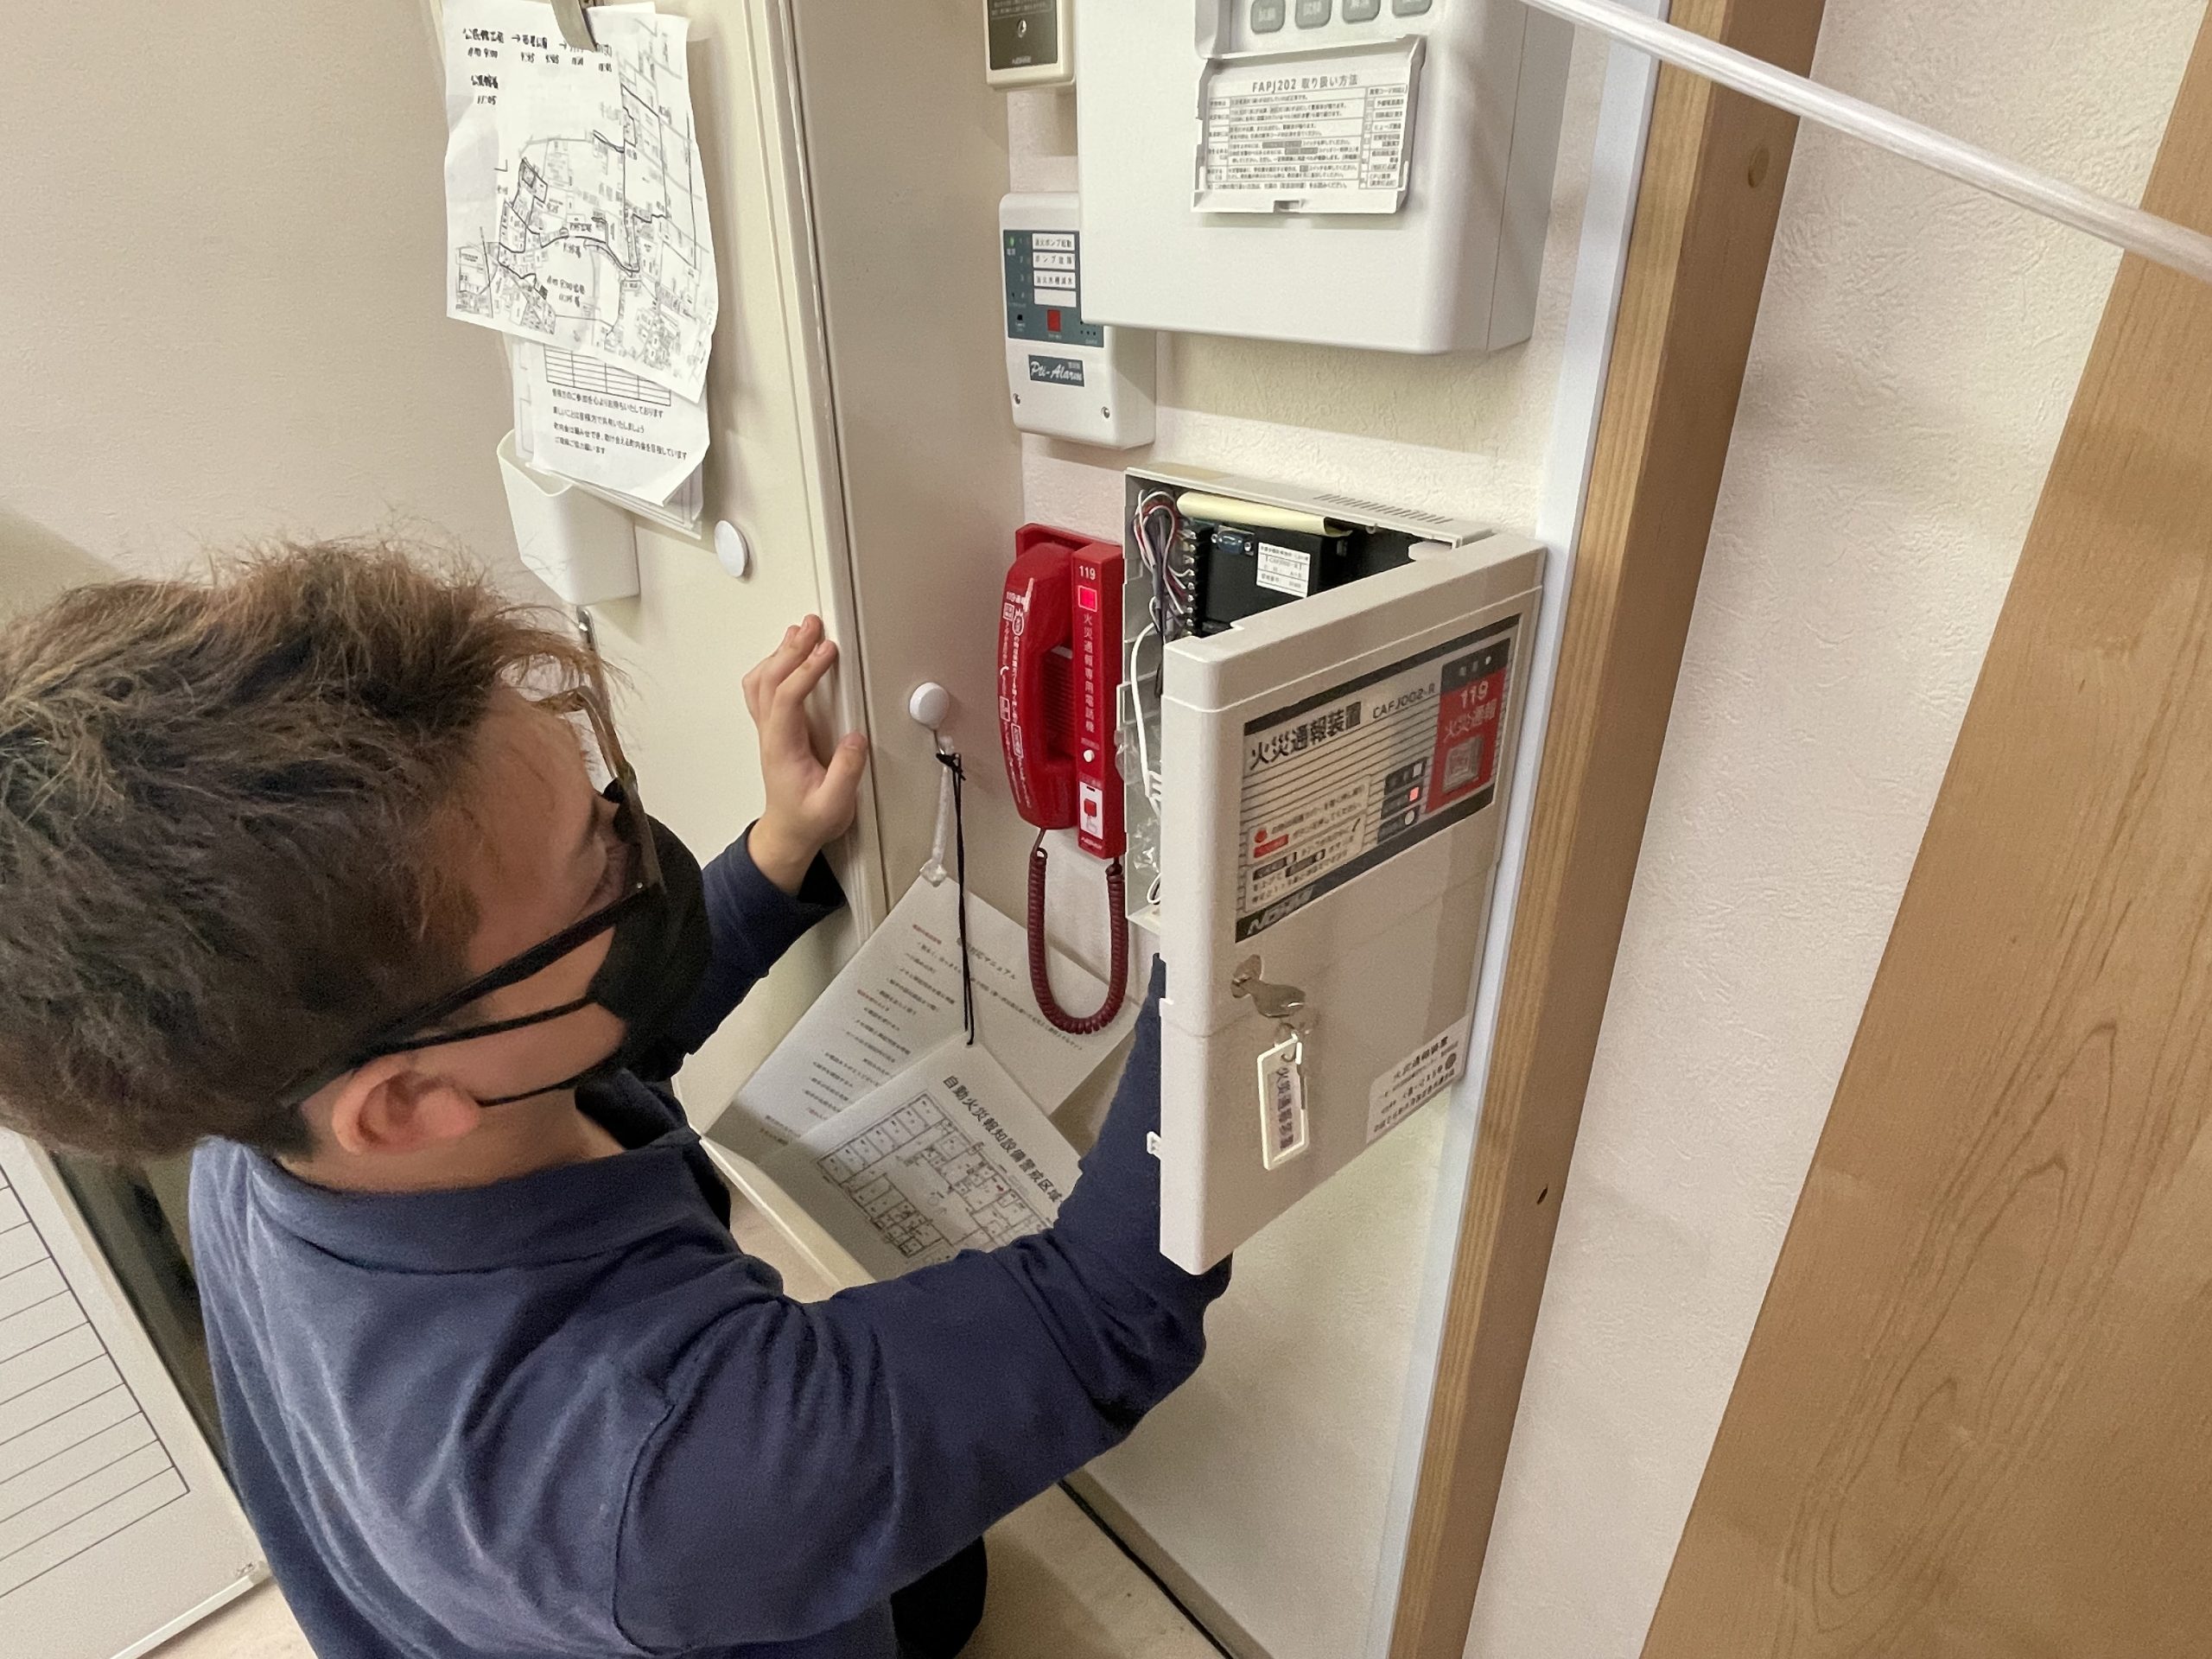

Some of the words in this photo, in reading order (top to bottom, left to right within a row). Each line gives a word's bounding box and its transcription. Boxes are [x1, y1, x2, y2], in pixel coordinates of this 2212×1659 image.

[1252, 78, 1297, 94] FAPJ202
[1301, 73, 1359, 90] 取り扱い方法
[1079, 566, 1096, 581] 119
[1083, 613, 1096, 734] 火災通報専用電話機
[1460, 680, 1489, 709] 119
[1249, 701, 1362, 771] 火災通報装置
[1444, 698, 1498, 741] 火災通報
